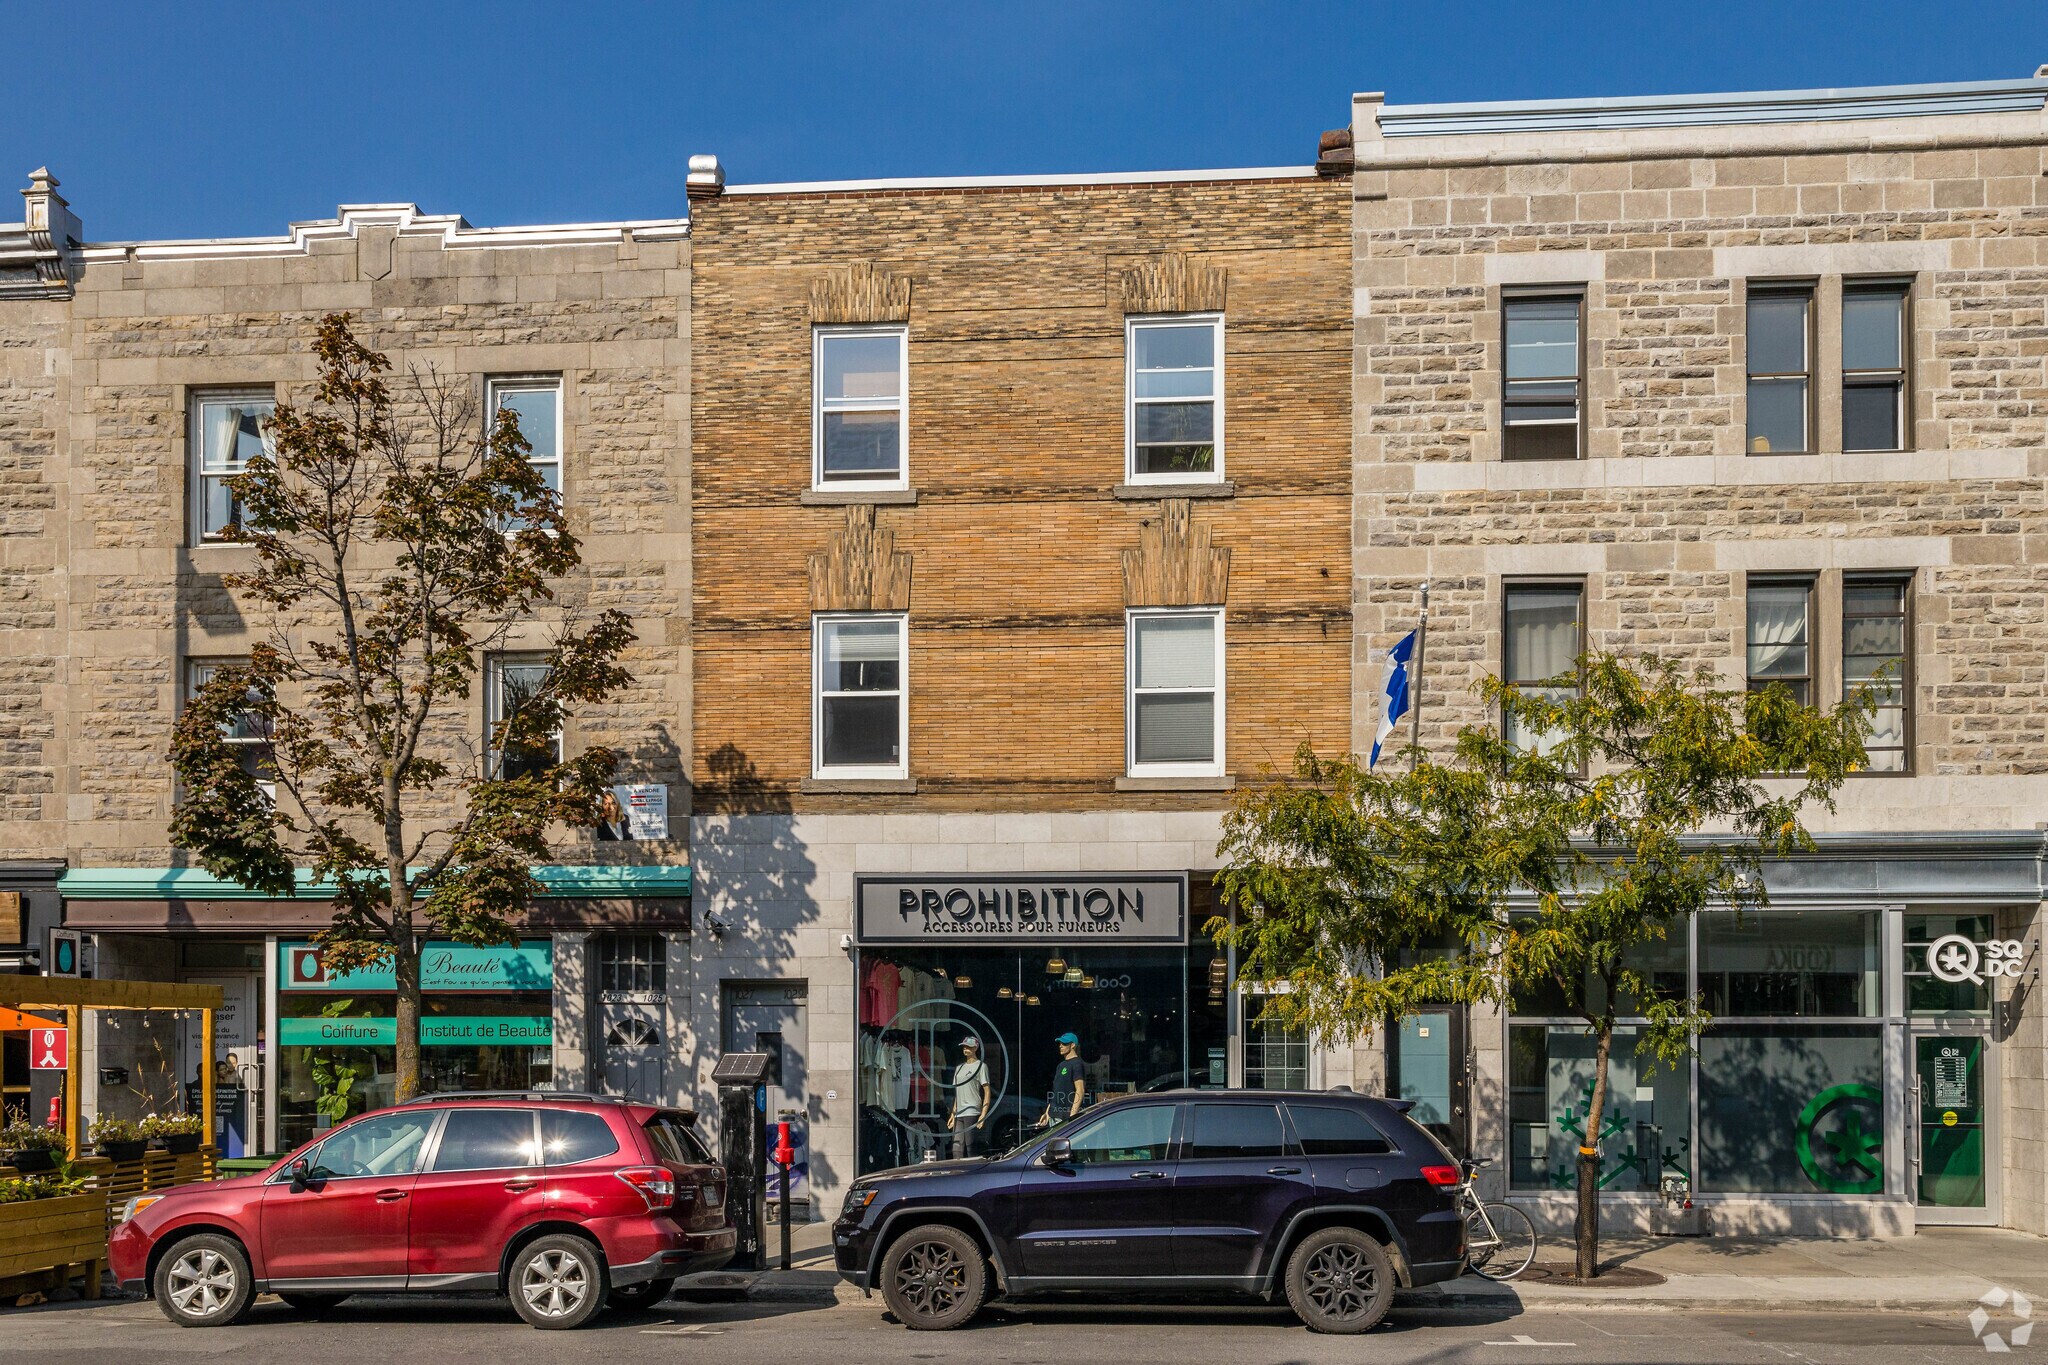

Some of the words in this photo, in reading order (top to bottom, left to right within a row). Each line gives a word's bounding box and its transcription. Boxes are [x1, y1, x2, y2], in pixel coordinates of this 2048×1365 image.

[899, 888, 1144, 922] PROHIBITION
[923, 921, 1013, 933] ACCESSOIRES
[1018, 921, 1055, 933] POUR
[1058, 921, 1120, 933] FUMEURS
[1985, 939, 2023, 959] SQ
[426, 951, 501, 974] Beauté
[1985, 958, 2022, 977] DC
[470, 978, 489, 987] qu'on
[603, 994, 622, 1002] 1023
[643, 994, 663, 1002] 1025
[321, 1024, 378, 1039] Coiffure
[421, 1023, 472, 1037] Institut
[476, 1023, 494, 1037] de
[499, 1023, 551, 1037] Beauté
